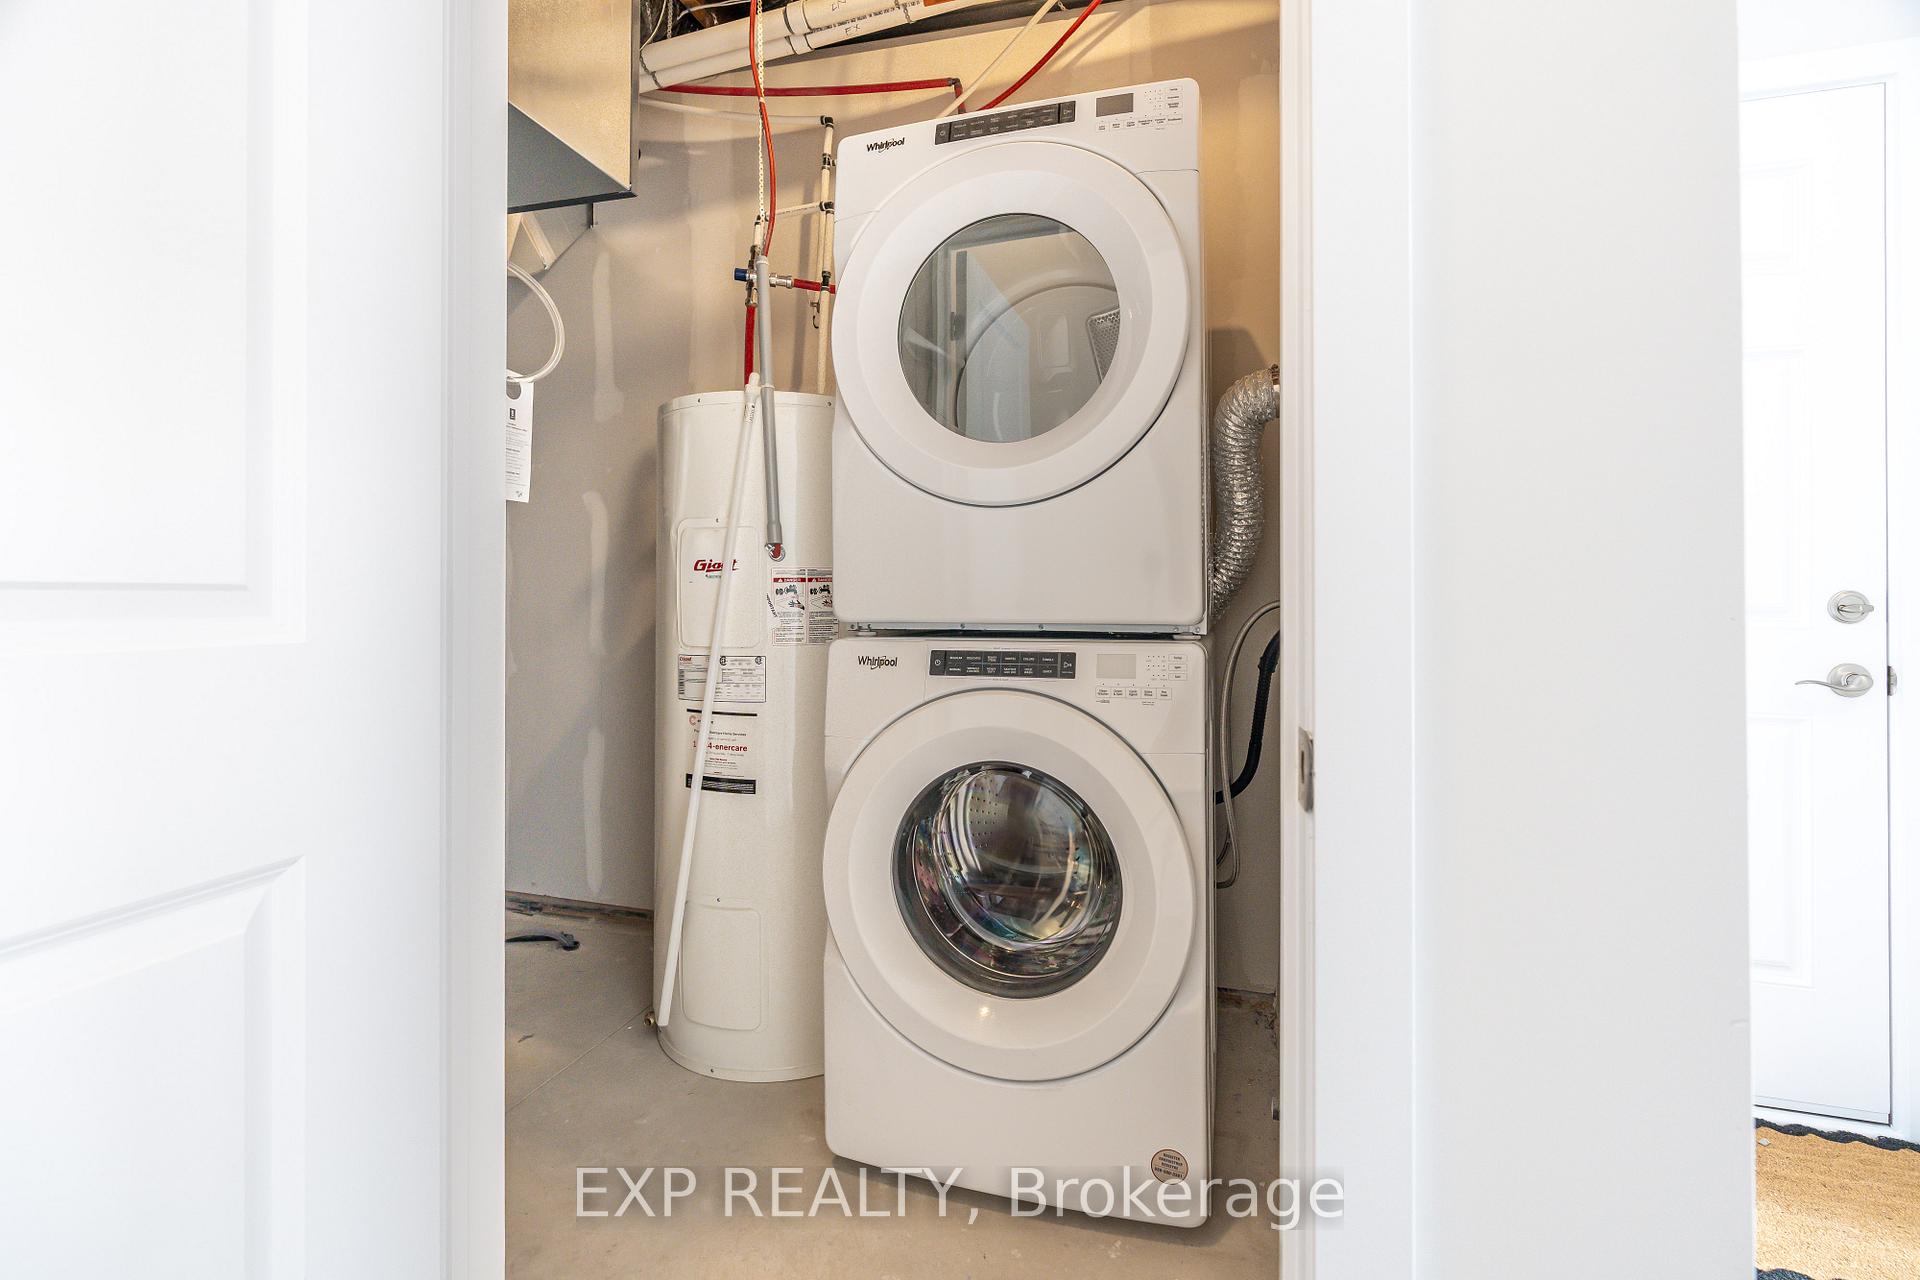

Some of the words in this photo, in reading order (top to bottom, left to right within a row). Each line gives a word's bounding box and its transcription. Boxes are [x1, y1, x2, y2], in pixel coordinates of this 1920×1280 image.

[866, 137, 905, 153] Whirlpool
[693, 559, 740, 573] Giat
[857, 655, 898, 670] Whirlpool
